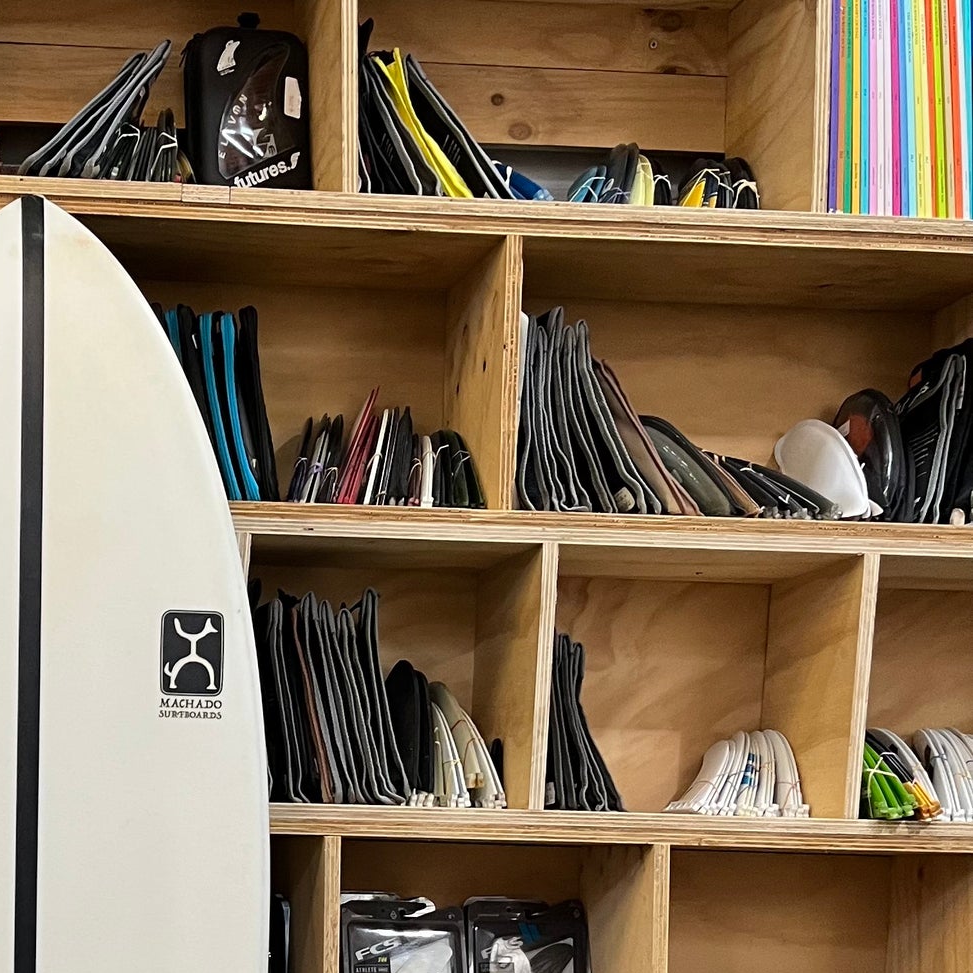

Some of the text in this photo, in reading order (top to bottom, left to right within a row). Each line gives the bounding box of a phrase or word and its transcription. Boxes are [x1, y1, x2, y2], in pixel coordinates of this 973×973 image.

[218, 94, 248, 159] ELVON
[158, 710, 223, 720] SURFBOARDS
[159, 697, 223, 709] MACHADO
[355, 937, 402, 961] FCS
[481, 936, 524, 960] FS
